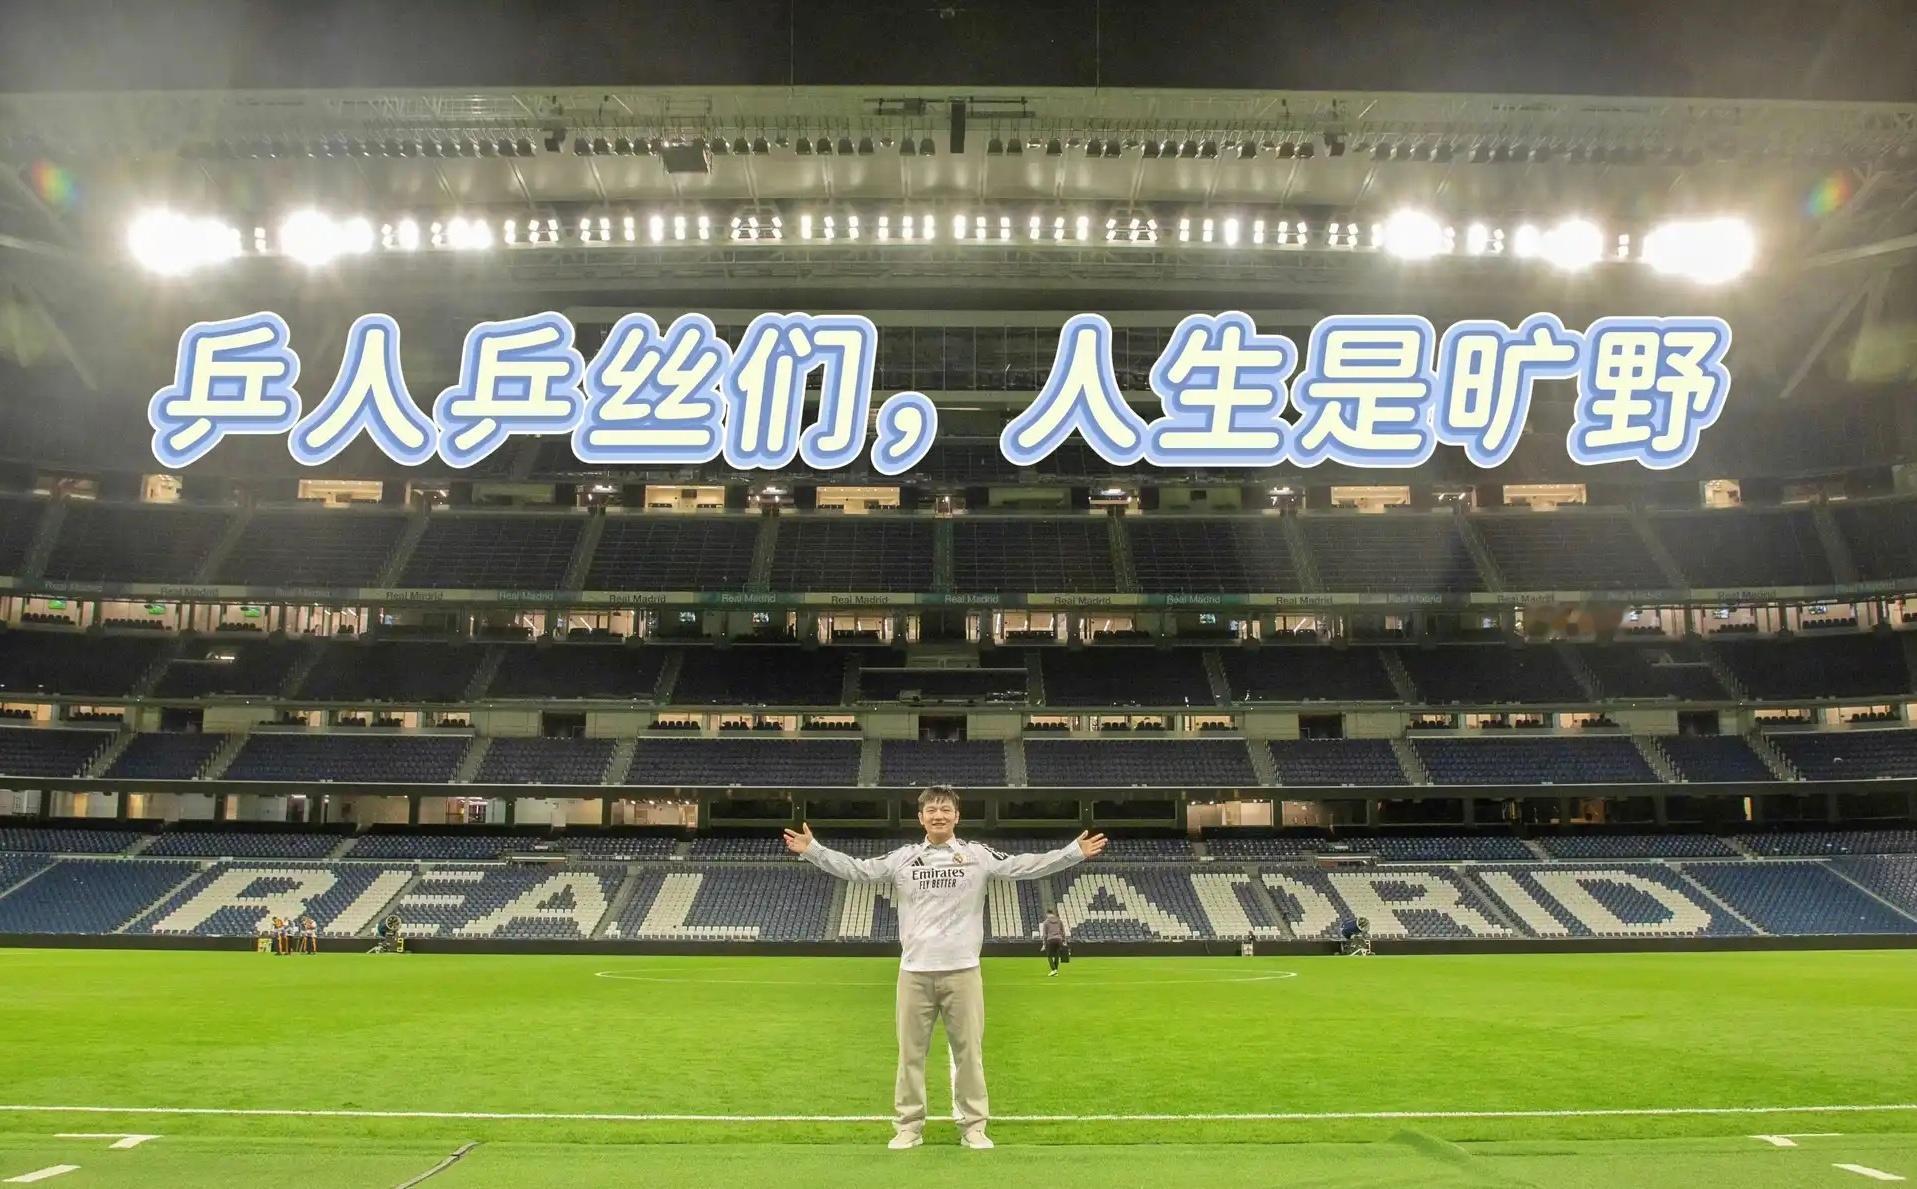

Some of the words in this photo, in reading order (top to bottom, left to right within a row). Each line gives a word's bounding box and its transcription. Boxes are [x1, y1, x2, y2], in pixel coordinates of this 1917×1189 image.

[386, 591, 407, 600] Real
[500, 591, 519, 600] Real
[609, 594, 630, 604] Real
[633, 594, 666, 604] Madrid
[721, 593, 742, 602] Real
[745, 594, 776, 603] Madrid
[831, 595, 851, 605] Real
[855, 595, 888, 605] Madrid
[944, 594, 964, 604] Real
[967, 594, 999, 604] Madrid
[1054, 596, 1075, 605] Real
[1078, 596, 1111, 605] Madrid
[1166, 594, 1187, 604] Real
[1189, 594, 1221, 604] Madrid
[1276, 596, 1297, 605] Real
[912, 867, 965, 881] Emirates
[919, 880, 930, 890] FLY
[931, 878, 957, 889] BETTER
[152, 868, 760, 937] REAL
